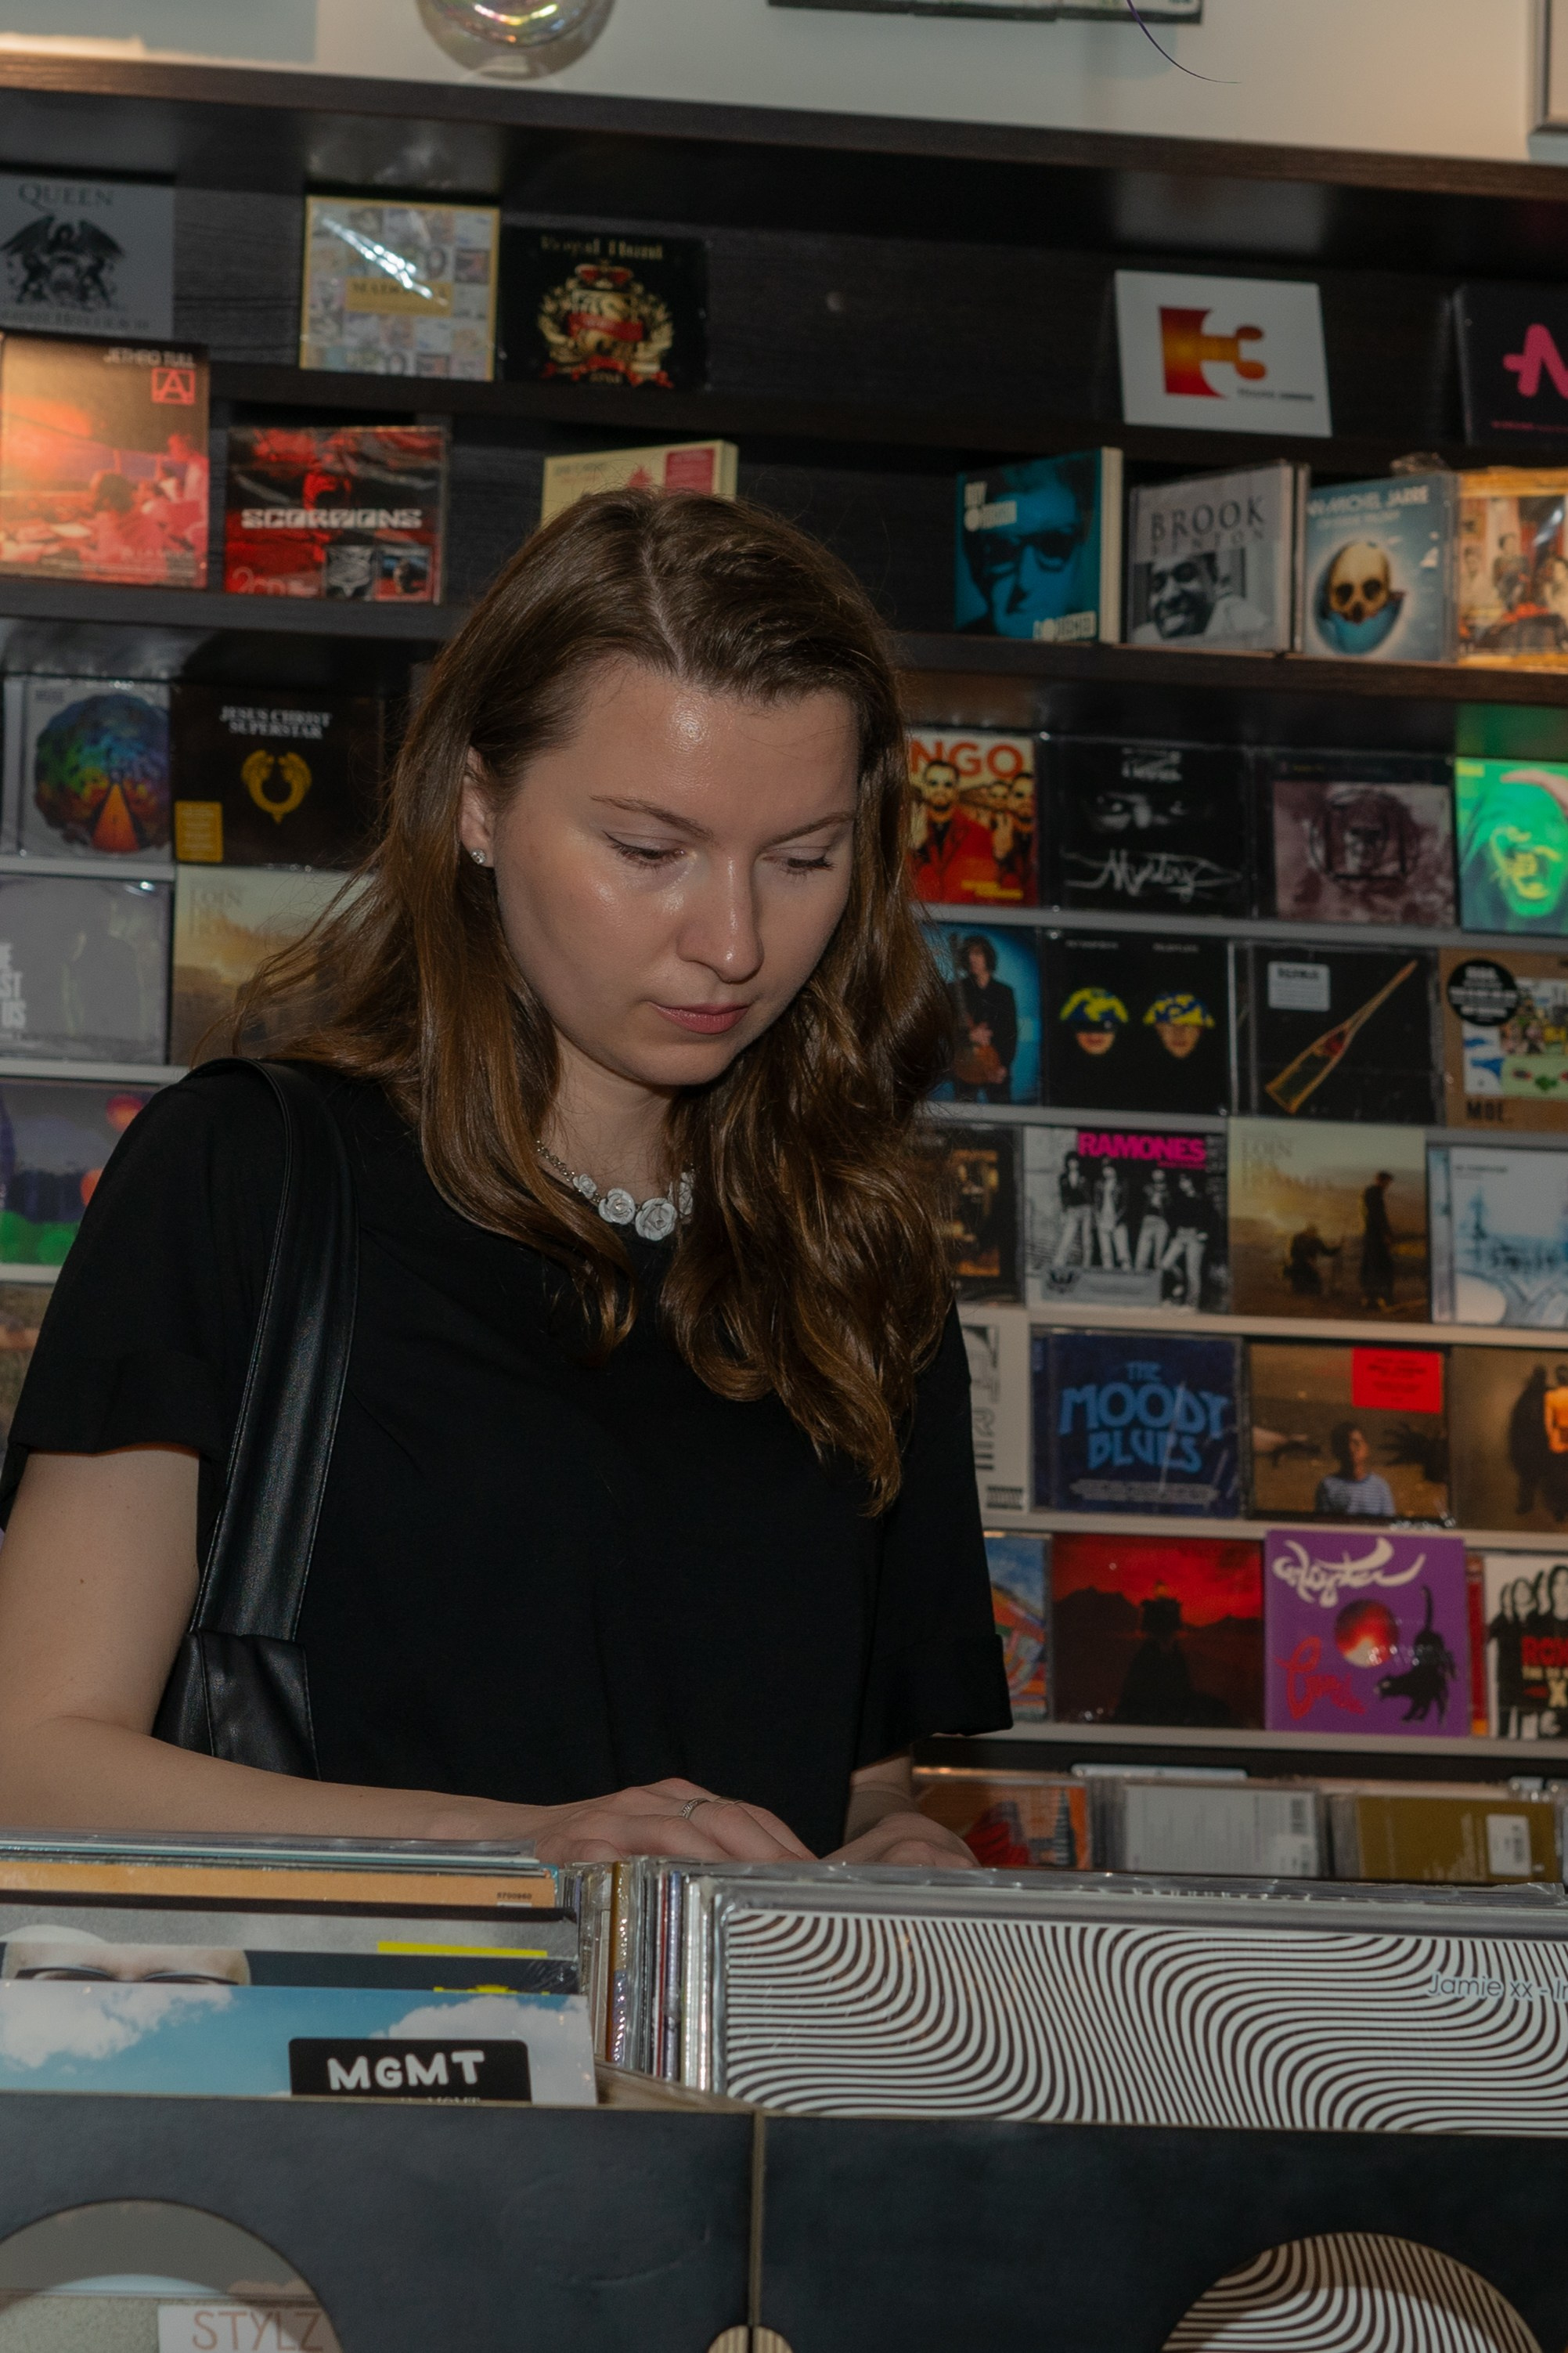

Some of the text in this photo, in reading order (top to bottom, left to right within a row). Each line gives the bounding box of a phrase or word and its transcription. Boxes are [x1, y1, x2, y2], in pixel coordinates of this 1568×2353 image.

[18, 182, 115, 210] QUEEN
[241, 508, 423, 529] SCORPIONS
[1151, 496, 1265, 542] BROOK
[270, 708, 333, 728] CHRIST
[910, 738, 1023, 778] NGO
[1077, 1131, 1206, 1161] RAMONES
[1123, 1360, 1162, 1383] THE
[1059, 1380, 1231, 1441] MOODY
[1087, 1429, 1202, 1474] BLUES
[1428, 1974, 1501, 1996] Jamie
[1510, 1982, 1533, 1998] xx
[326, 2049, 485, 2091] MGMT
[192, 2310, 323, 2351] STYLZ
